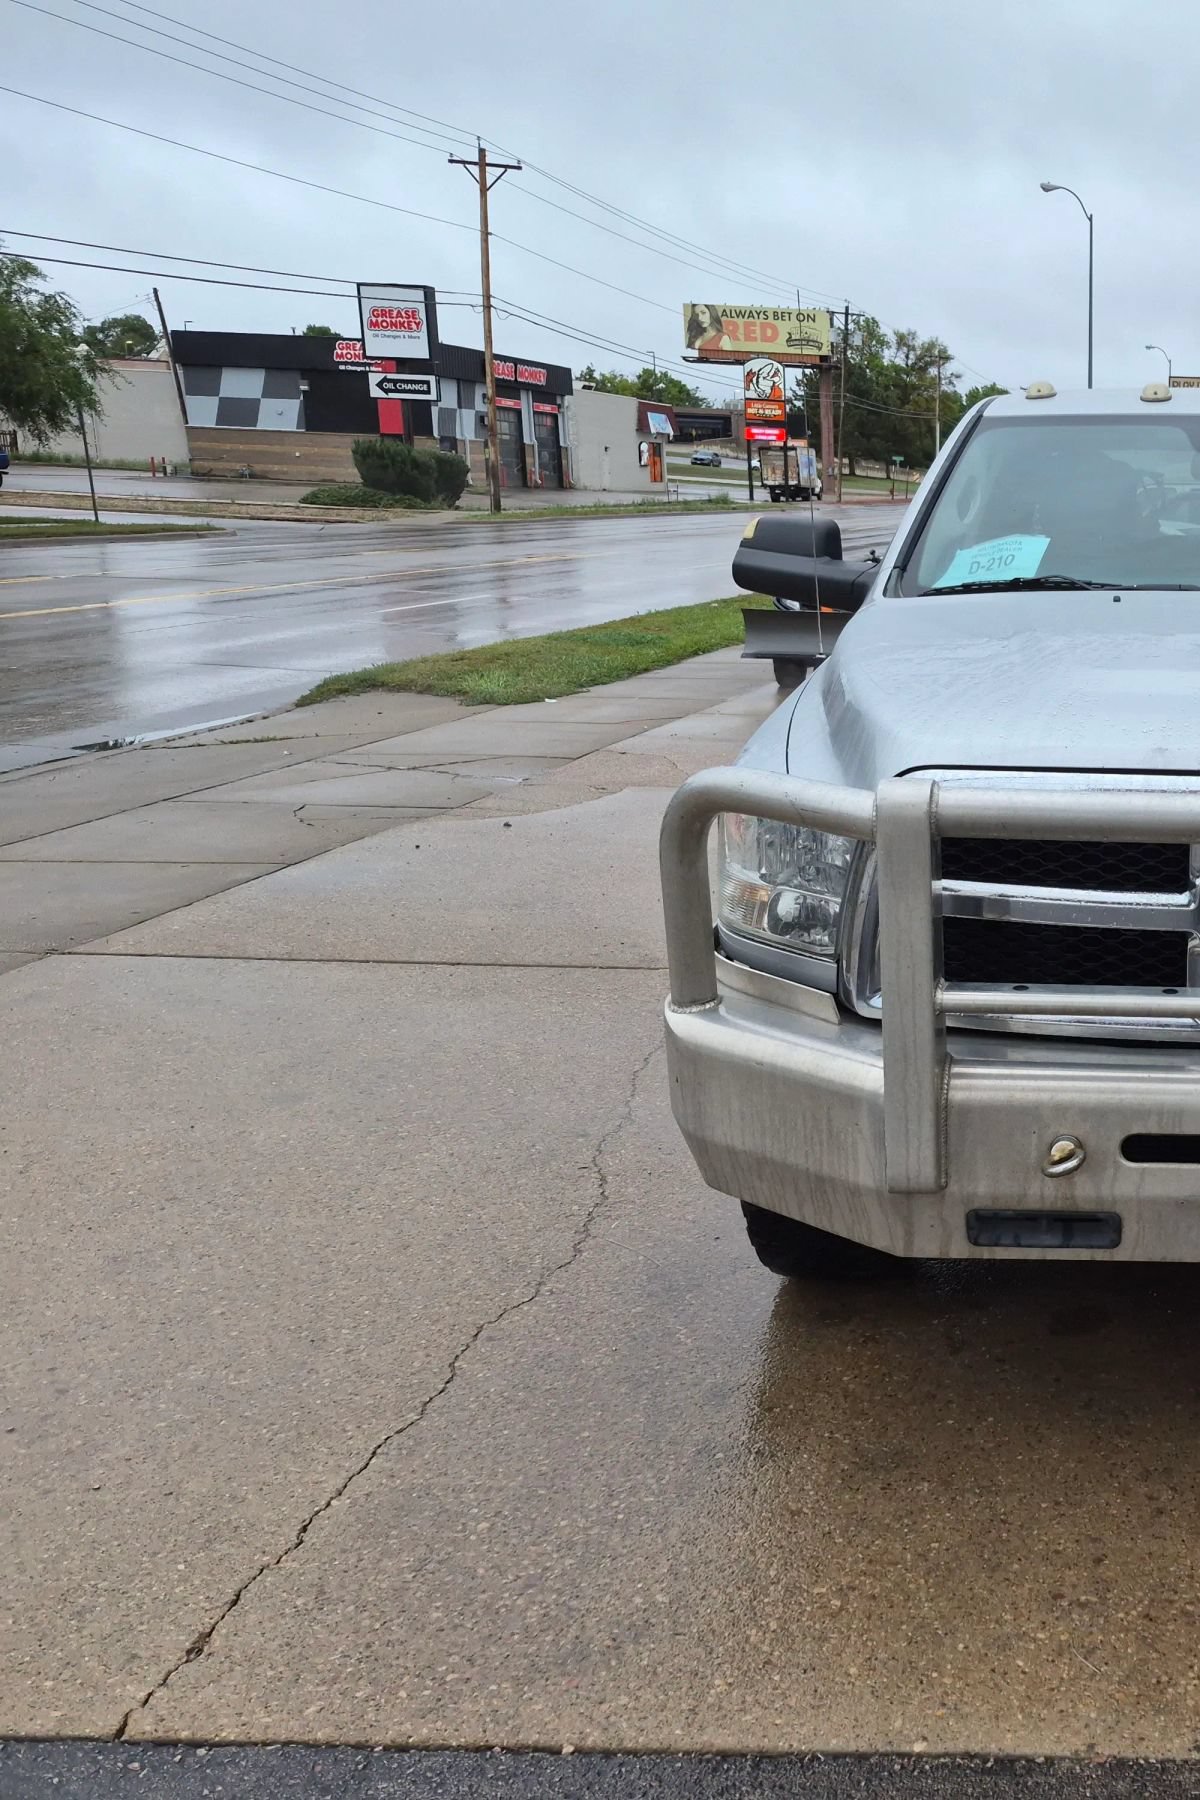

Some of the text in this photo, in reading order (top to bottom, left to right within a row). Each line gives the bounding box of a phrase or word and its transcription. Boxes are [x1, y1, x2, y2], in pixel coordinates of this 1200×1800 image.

[371, 308, 418, 320] GREASE
[720, 308, 816, 323] ALWAYS BET ON
[368, 319, 422, 331] MONKEY
[723, 319, 779, 343] RED
[336, 341, 363, 352] GRE
[335, 351, 363, 361] MON
[493, 361, 547, 385] REASE MONKEY
[382, 382, 429, 391] OIL CHANGE
[968, 554, 1015, 575] D-210
